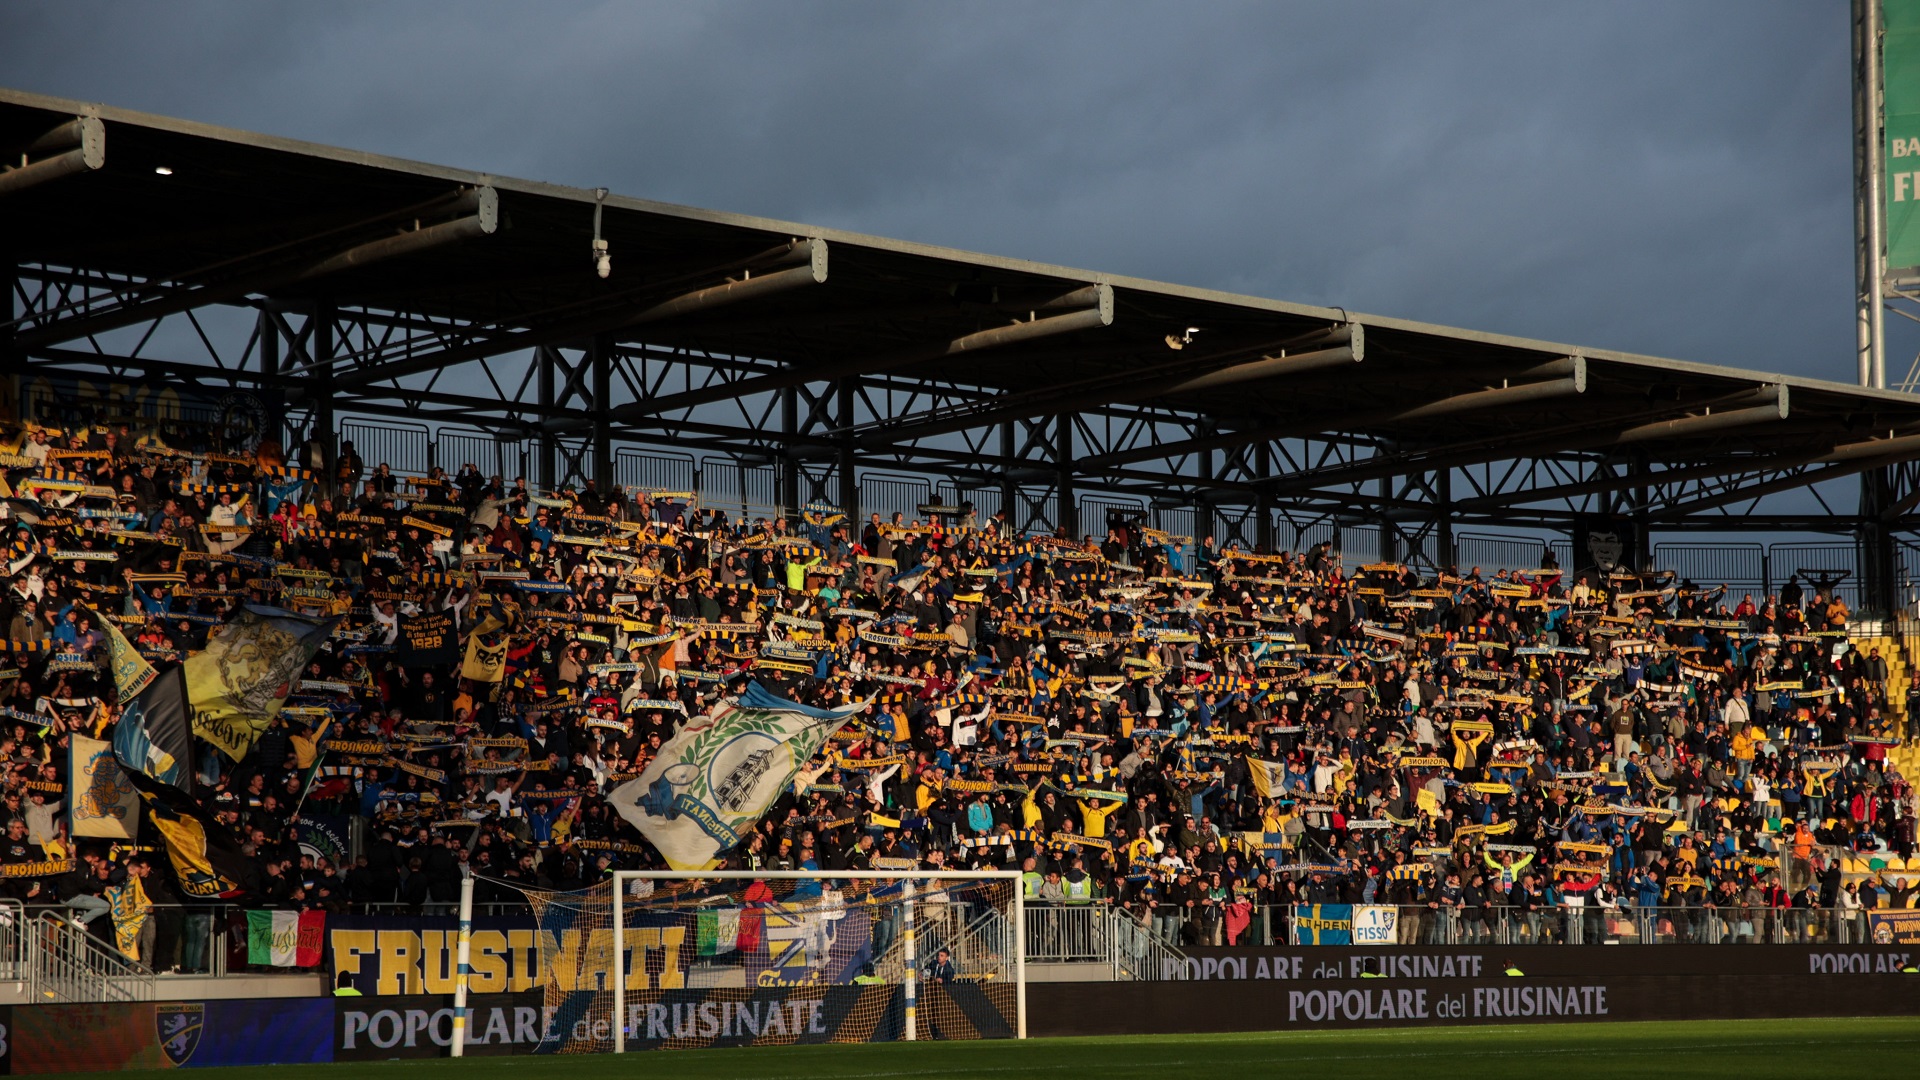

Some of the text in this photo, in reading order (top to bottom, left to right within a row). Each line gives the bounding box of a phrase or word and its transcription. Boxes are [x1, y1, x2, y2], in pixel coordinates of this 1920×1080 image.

[411, 636, 443, 651] 1928
[864, 633, 901, 644] FROSINONE
[329, 741, 384, 753] FROSINONE
[950, 780, 992, 792] FROSINONE
[6, 860, 67, 876] FROSINONE
[1369, 910, 1378, 926] 1
[1356, 927, 1387, 941] FISSO
[331, 926, 686, 995] FRUSINATI
[1288, 985, 1609, 1022] POPOLARE del FRUSINATE
[628, 999, 827, 1041] FRUSINATE
